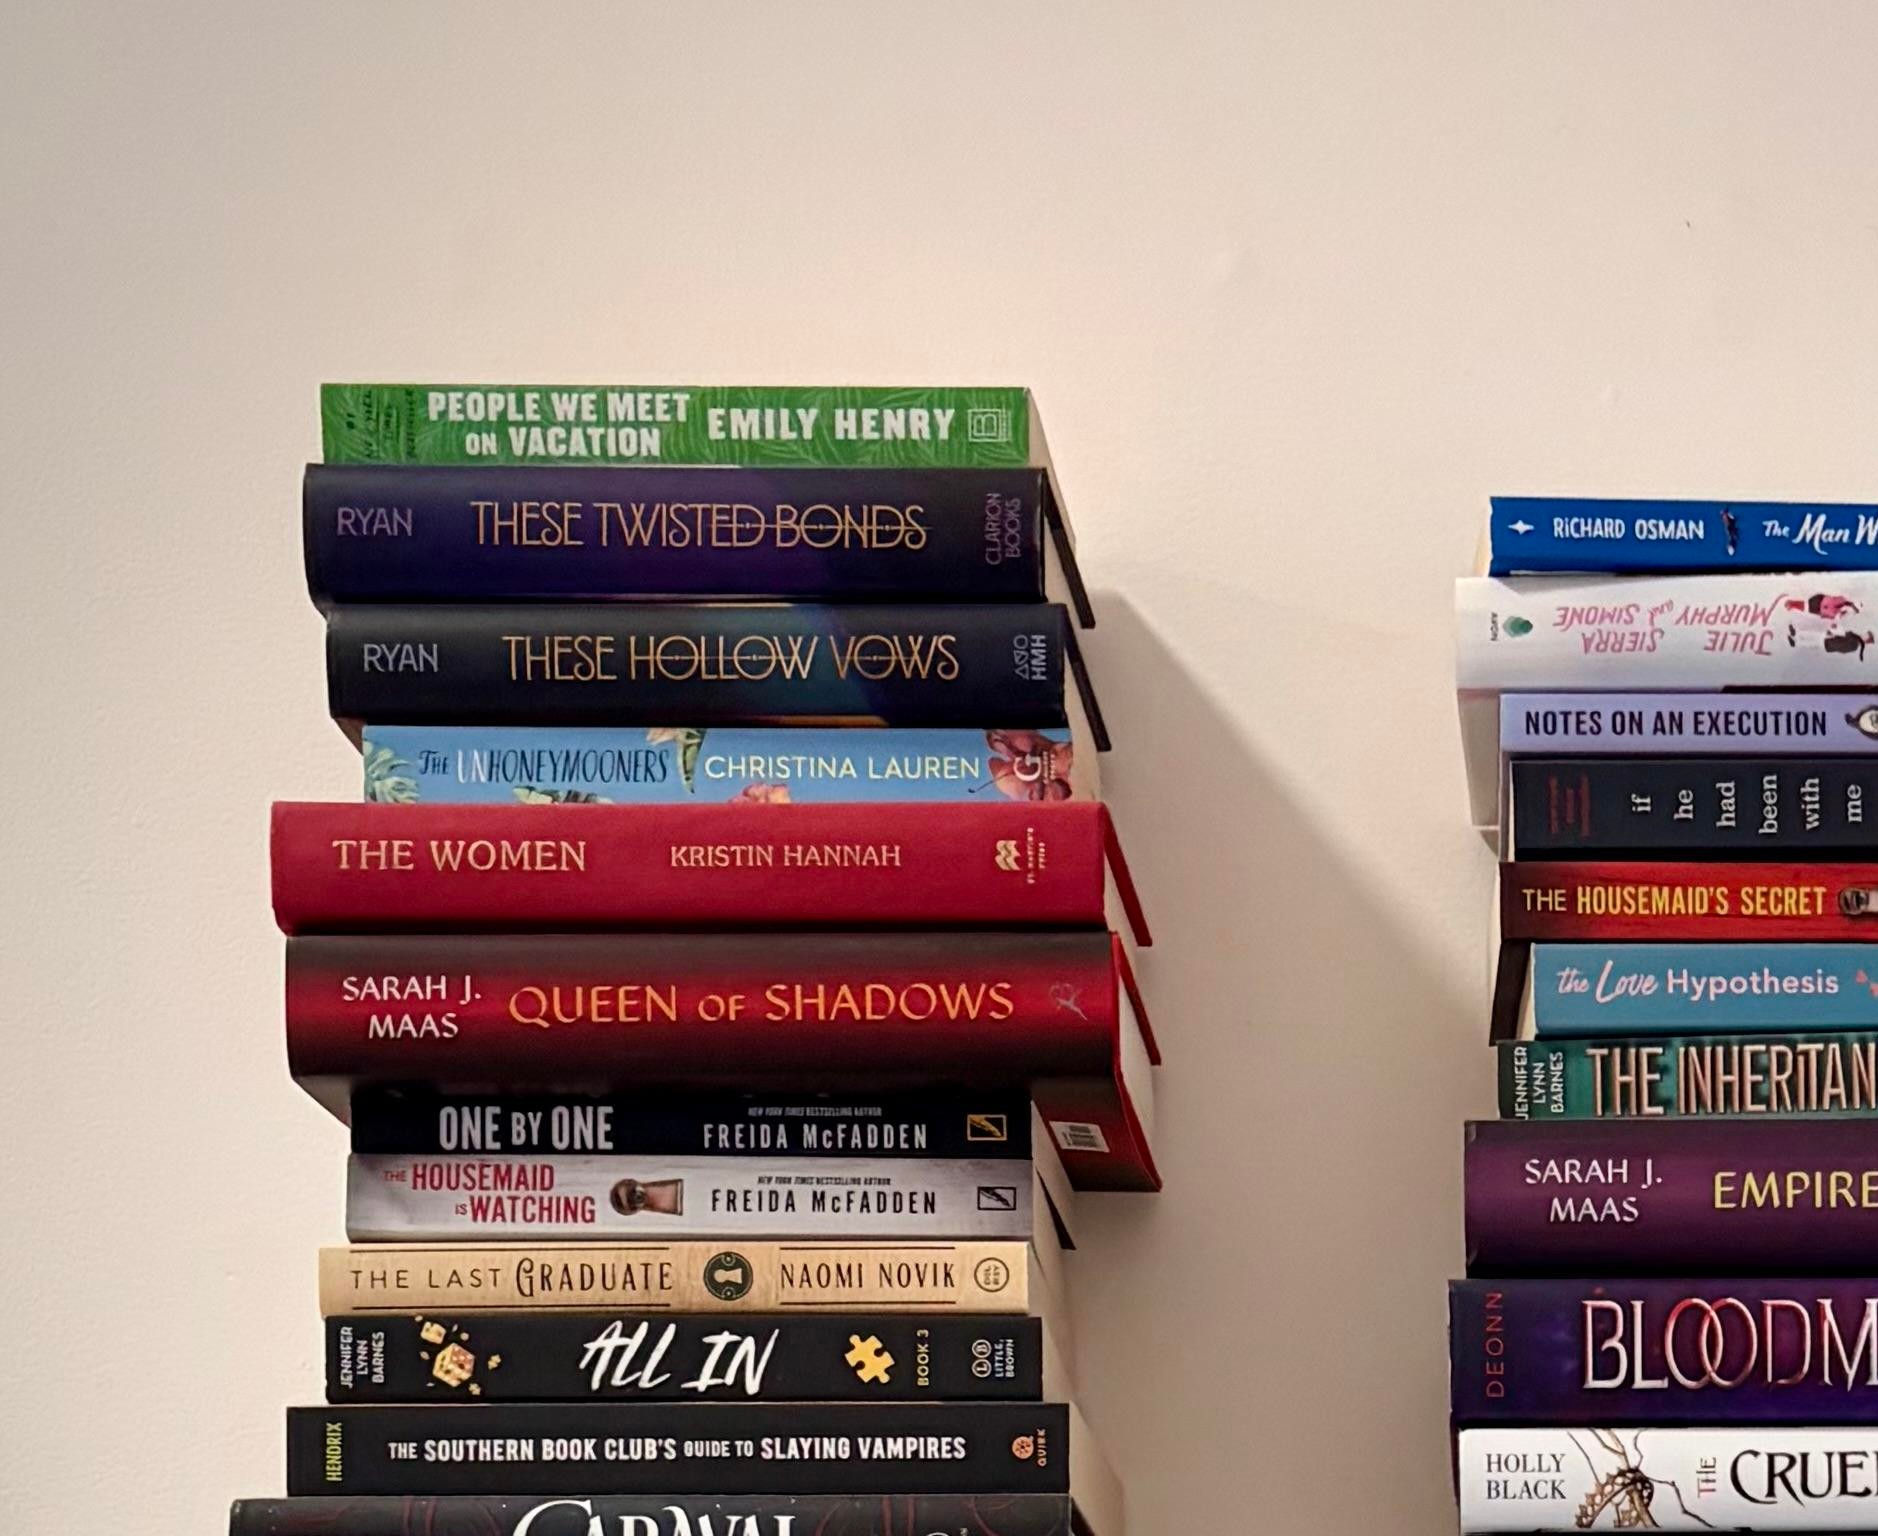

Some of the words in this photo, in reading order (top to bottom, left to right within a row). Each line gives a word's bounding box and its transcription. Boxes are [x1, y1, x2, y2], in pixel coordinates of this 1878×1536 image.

[428, 391, 544, 422] PEOPLE
[551, 394, 599, 421] WE
[607, 393, 689, 422] MEET
[707, 408, 817, 440] EMILY
[836, 408, 953, 440] HENRY
[466, 432, 497, 455] ON
[509, 427, 660, 457] VACATION
[336, 508, 411, 536] RYAN
[471, 500, 583, 548] THESE
[594, 502, 766, 549] TWISTED
[774, 503, 926, 551] BONDS
[986, 492, 999, 564] CLARION
[1006, 498, 1021, 558] BOOKS
[1031, 634, 1046, 679] HMH
[705, 754, 857, 780] CHRISTINA
[868, 754, 980, 780] LAUREN
[333, 840, 414, 872] THE
[430, 840, 587, 872] WOMEN
[670, 845, 773, 867] KRISTIN
[784, 845, 901, 867] HANNAH
[1523, 888, 1567, 913] THE
[1576, 885, 1731, 916] HOUSEMAID'S
[1741, 886, 1826, 916] SECRET
[1667, 968, 1840, 1001] Hypothesis
[1514, 1046, 1529, 1120] JENNIFER
[1533, 1062, 1546, 1103] LYNN
[1549, 1051, 1564, 1113] BARNES
[350, 1269, 409, 1289] THE
[429, 1266, 502, 1288] LAST
[516, 1257, 673, 1296] GRADUATE
[781, 1263, 865, 1289] NAOMI
[879, 1261, 956, 1289] NOVIK
[916, 1329, 929, 1338] 3
[1487, 1292, 1503, 1396] DEONN
[340, 1326, 353, 1389] JENNIFER
[357, 1340, 368, 1375] LYNN
[372, 1332, 385, 1383] BARNES
[916, 1343, 929, 1386] BOOK
[325, 1423, 342, 1481] HENDRIX
[388, 1442, 418, 1459] THE
[424, 1435, 534, 1461] SOUTHERN
[542, 1435, 597, 1460] BOOK
[684, 1441, 727, 1458] GUIDE
[734, 1440, 754, 1456] TO
[761, 1436, 850, 1459] SLAYING
[857, 1435, 966, 1459] VAMPIRES
[1486, 1453, 1564, 1473] HOLLY
[1486, 1477, 1565, 1500] BLACK
